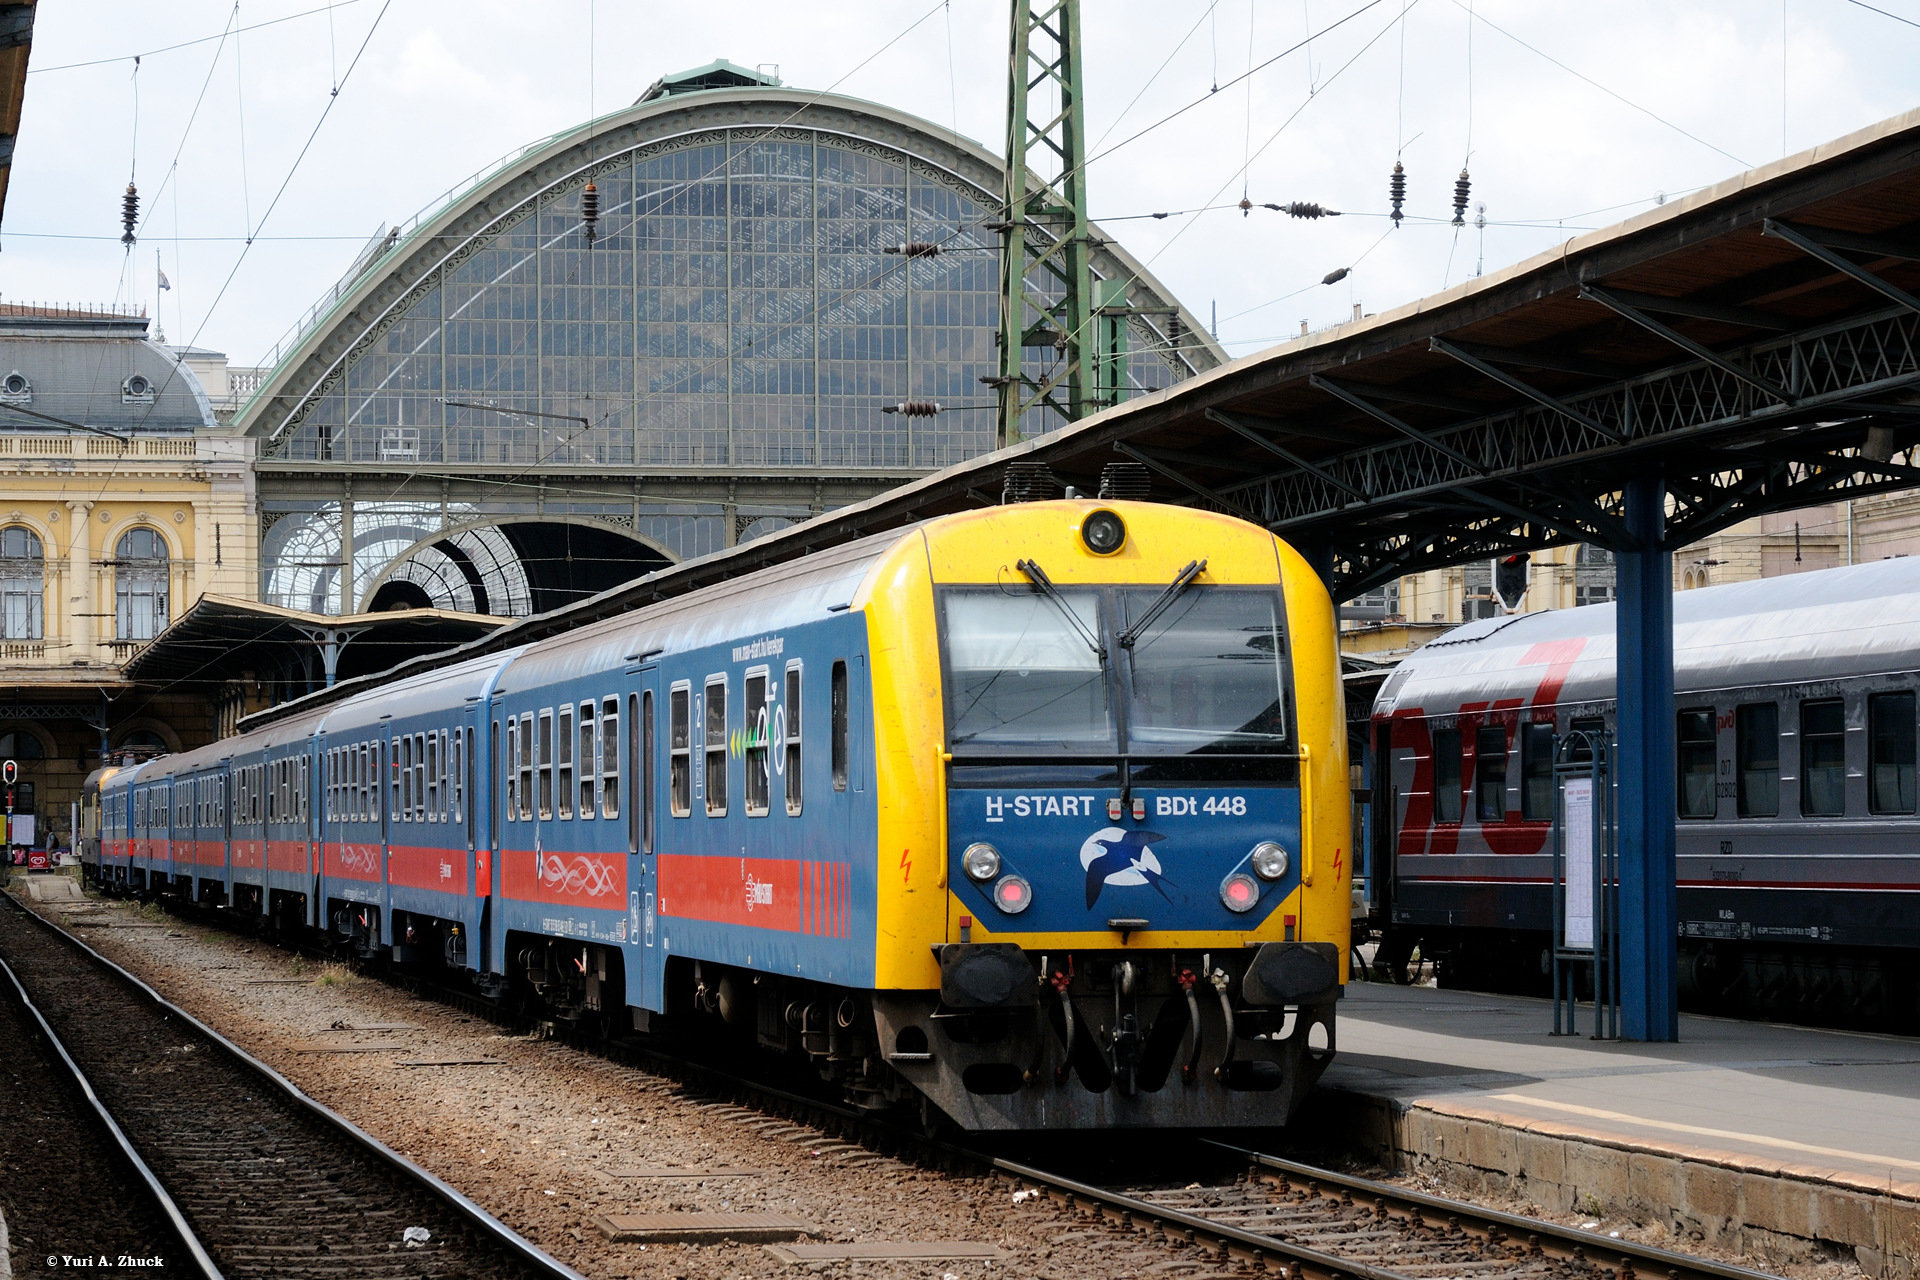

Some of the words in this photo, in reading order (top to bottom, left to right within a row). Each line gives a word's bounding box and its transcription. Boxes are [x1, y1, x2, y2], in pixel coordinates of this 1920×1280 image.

[696, 698, 701, 728] 2
[986, 796, 1095, 818] H-START
[1156, 796, 1197, 816] BDt
[1202, 796, 1247, 816] 448
